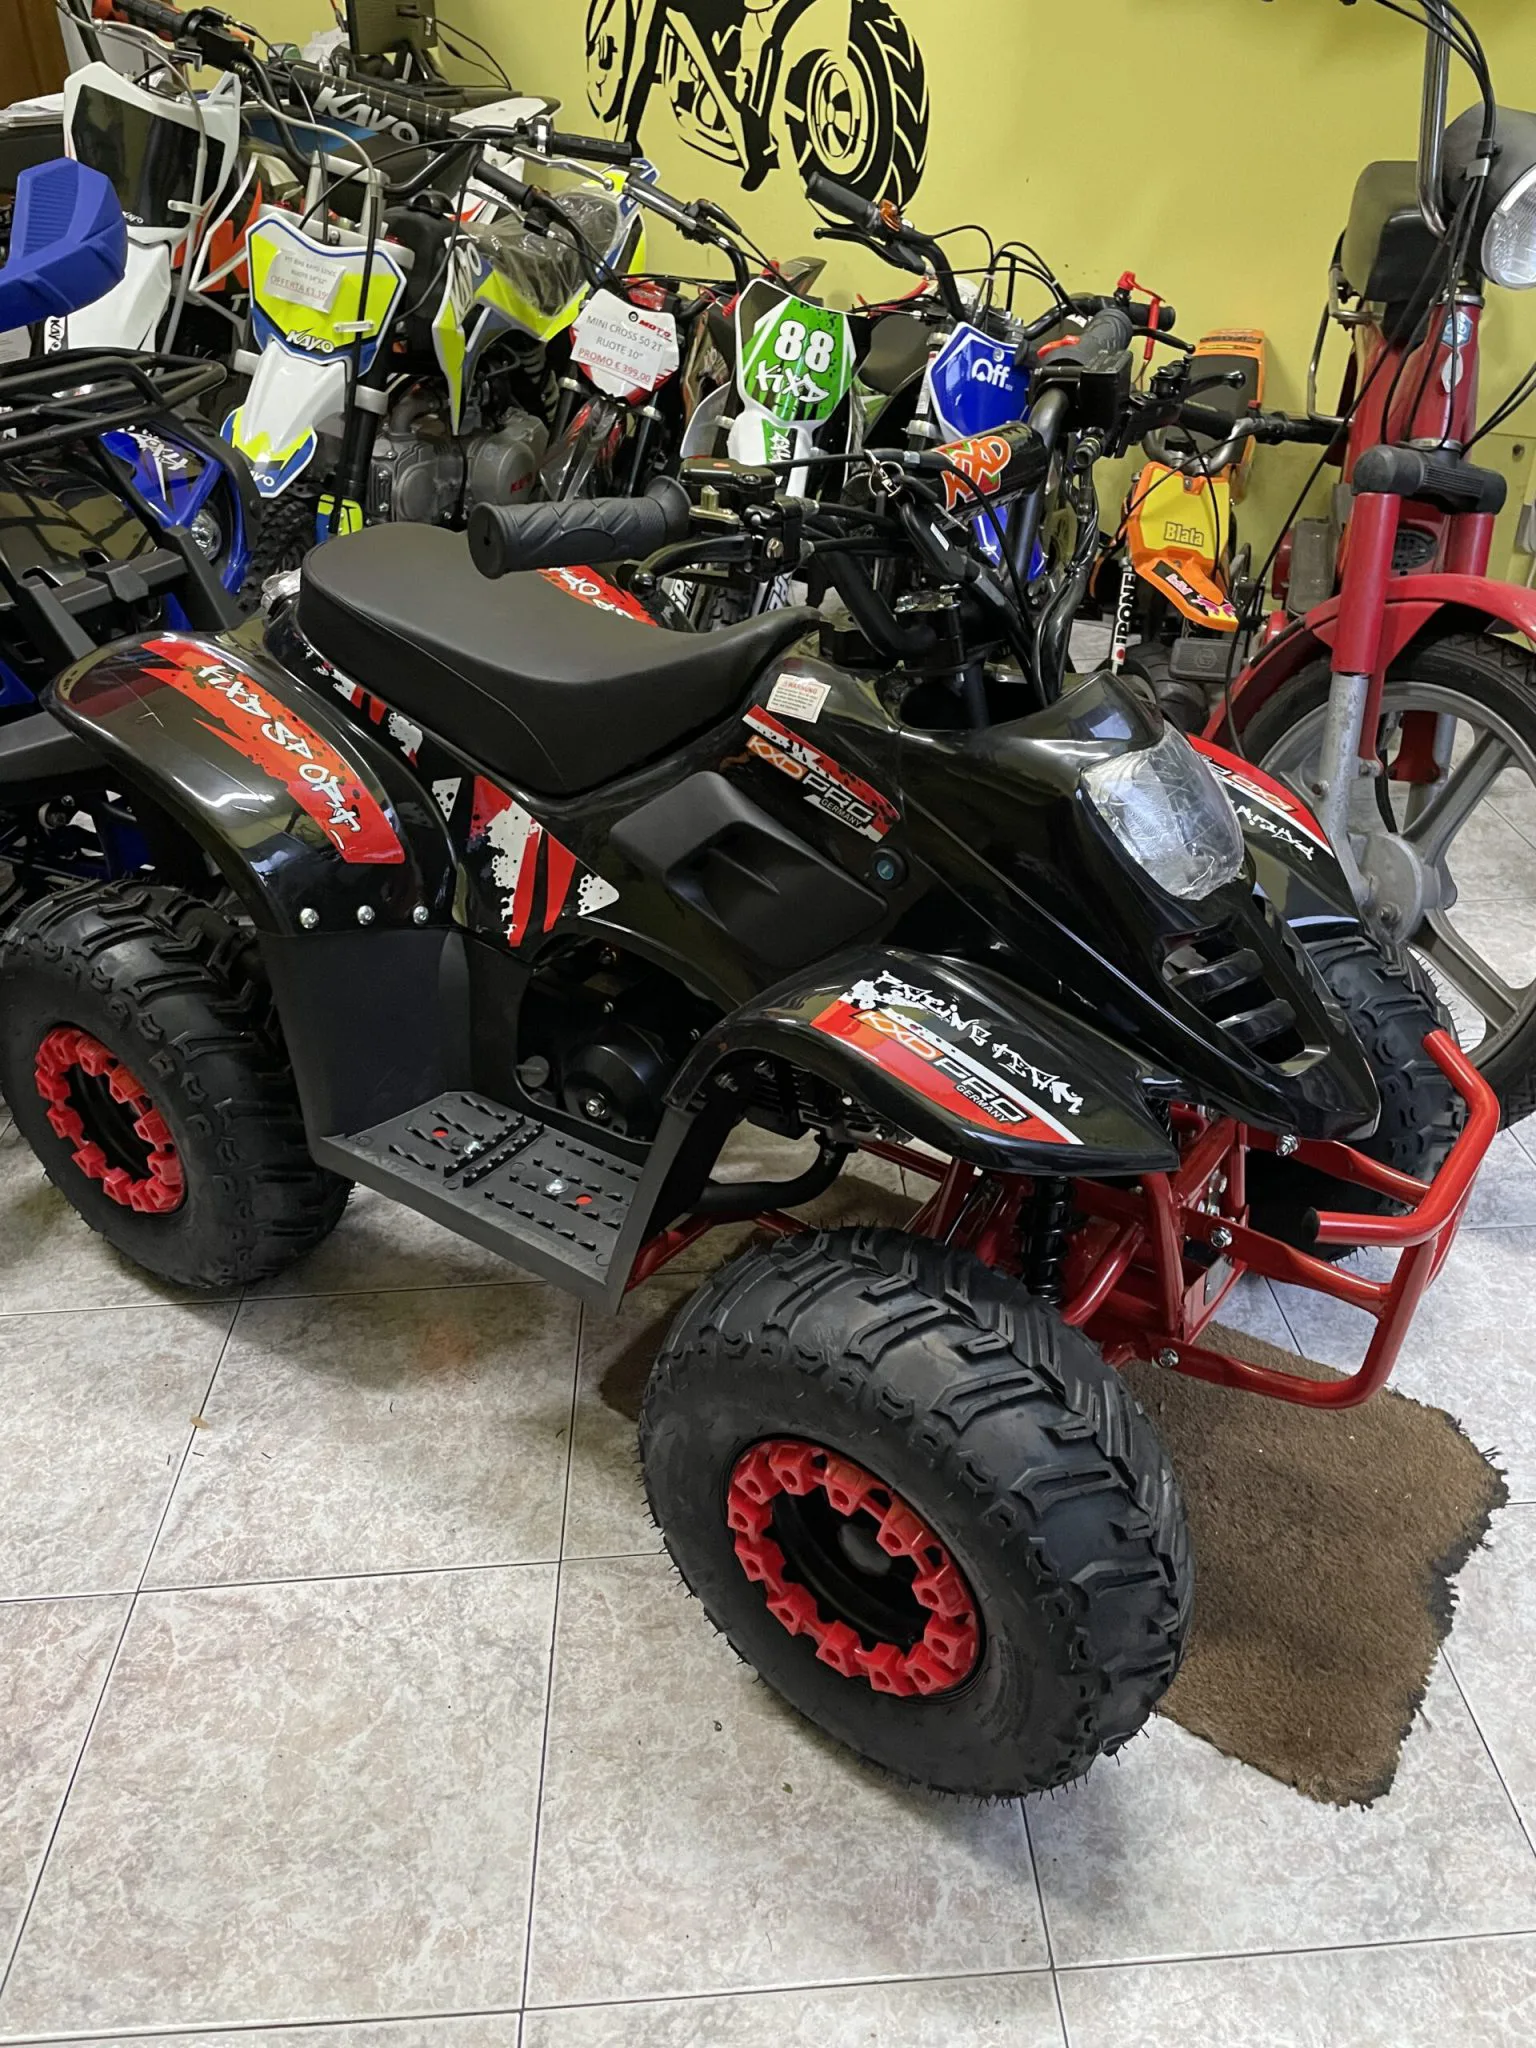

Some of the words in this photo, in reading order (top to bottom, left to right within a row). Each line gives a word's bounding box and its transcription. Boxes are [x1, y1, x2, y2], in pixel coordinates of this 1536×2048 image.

[313, 87, 419, 144] KAYO
[271, 275, 304, 291] OFFERTA
[49, 318, 64, 350] KAYO
[286, 328, 335, 353] KAYO
[586, 315, 608, 330] MINI
[609, 323, 638, 341] CROSS
[639, 335, 650, 347] 50
[651, 342, 662, 353] 2T
[596, 336, 628, 355] RUOTE
[639, 320, 672, 337] MOTO
[774, 319, 835, 373] 88
[578, 347, 614, 367] PROMO
[623, 363, 652, 383] 399,00
[755, 360, 830, 403] KXD
[1164, 521, 1204, 547] Blata
[199, 665, 272, 719] KXD
[748, 736, 806, 780] KXD
[802, 772, 875, 823] PRO
[820, 798, 863, 828] GERMANY
[861, 1010, 939, 1060] KXD
[933, 1059, 1029, 1122] PRO
[956, 1083, 1009, 1123] GERMANY
